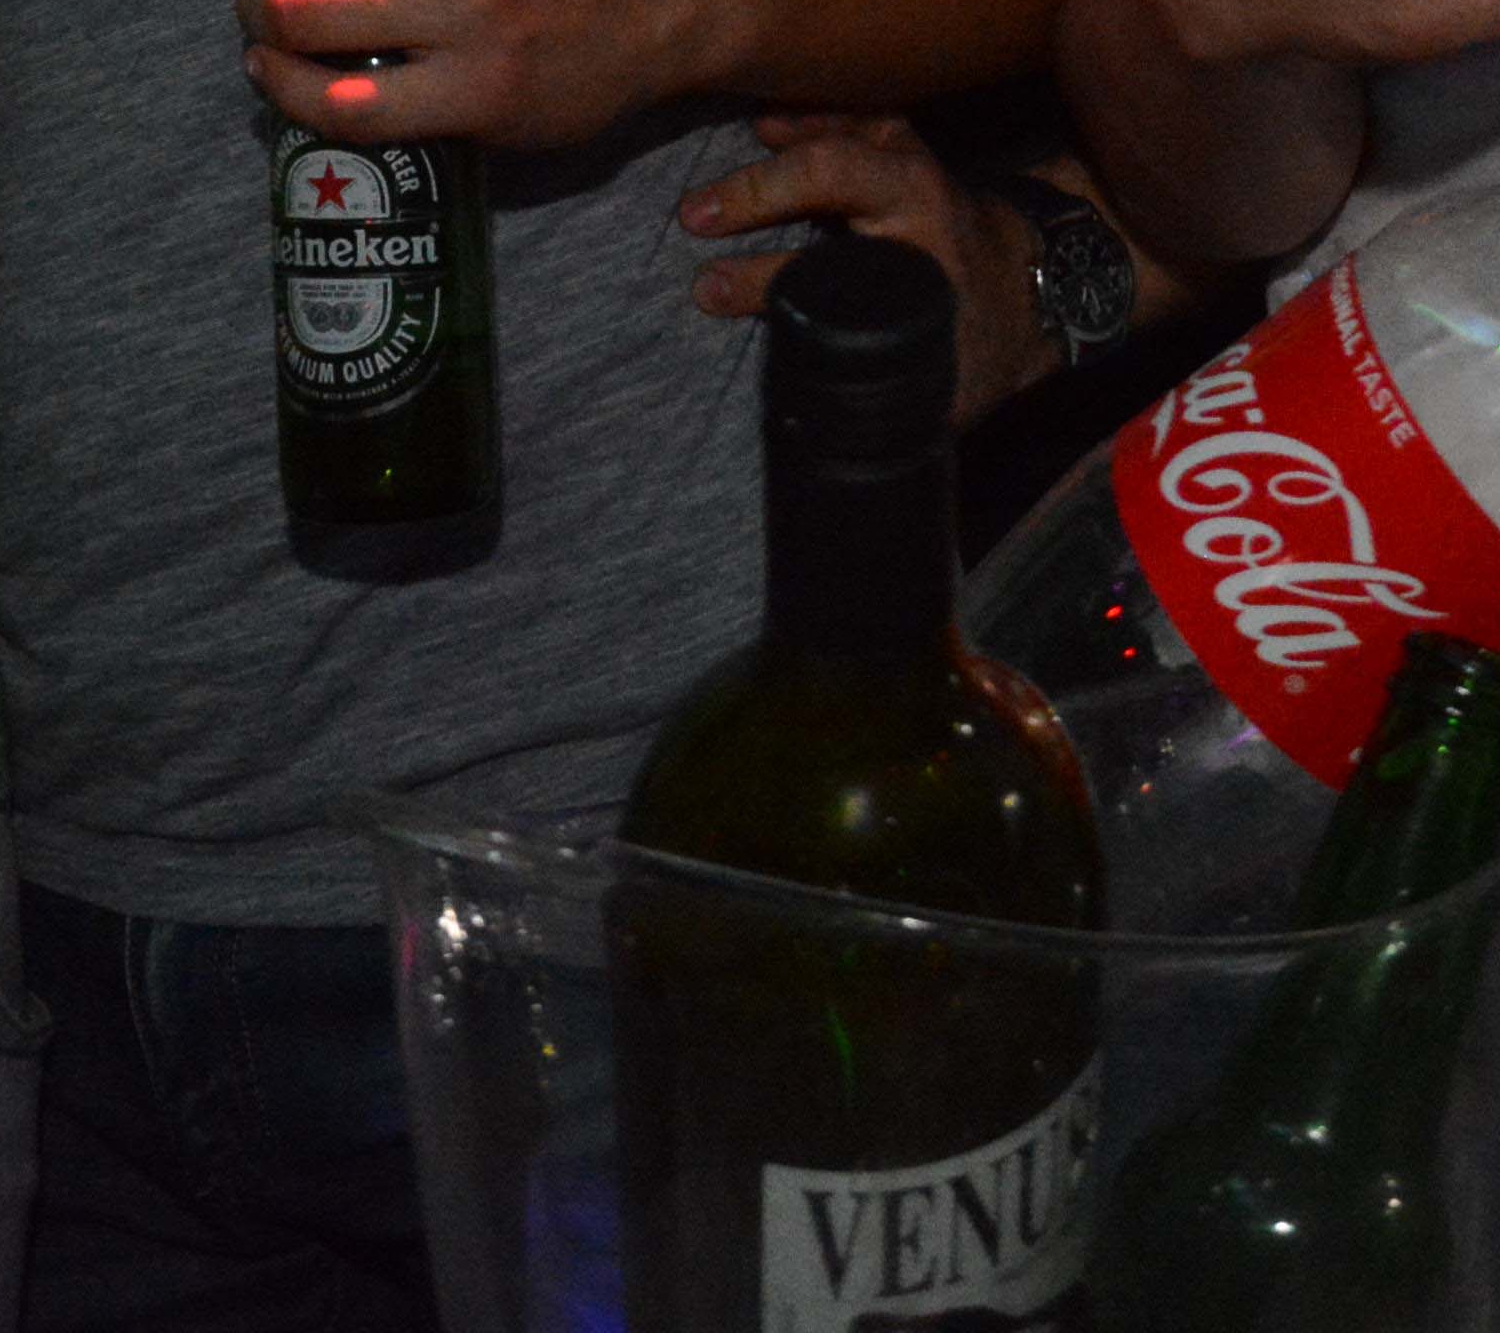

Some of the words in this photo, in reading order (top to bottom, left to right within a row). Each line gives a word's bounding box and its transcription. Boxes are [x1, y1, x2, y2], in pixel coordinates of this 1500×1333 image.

[275, 227, 439, 269] eineken
[341, 311, 422, 384] QUALITY
[1353, 351, 1418, 451] TASTE
[802, 1098, 1102, 1301] VENU
